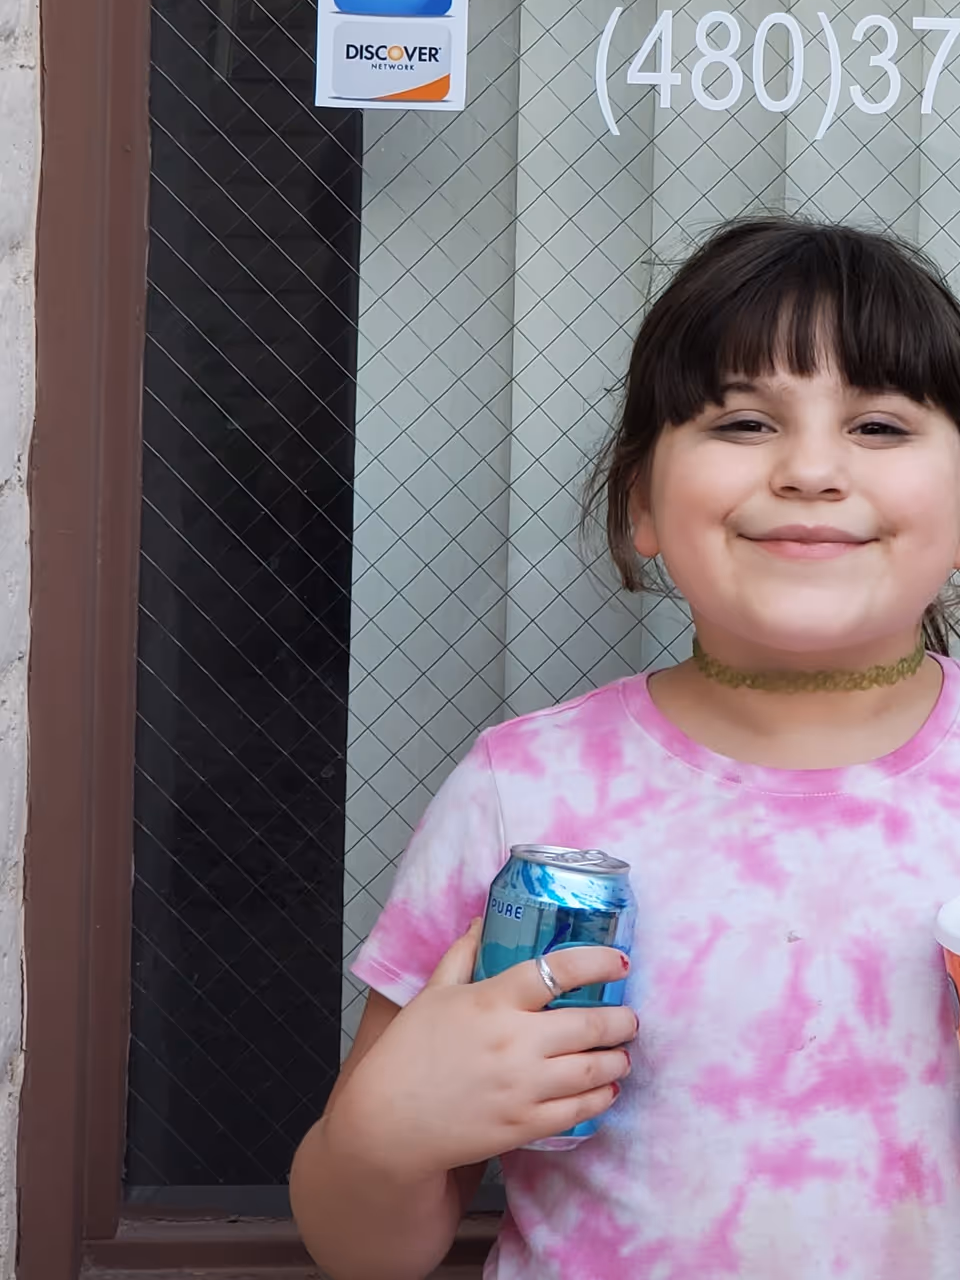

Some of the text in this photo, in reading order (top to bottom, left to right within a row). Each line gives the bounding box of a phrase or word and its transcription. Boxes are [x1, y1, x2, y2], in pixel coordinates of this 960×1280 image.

[345, 43, 440, 63] DISCOVER
[371, 63, 415, 72] NETWORK
[491, 897, 524, 921] PURE
